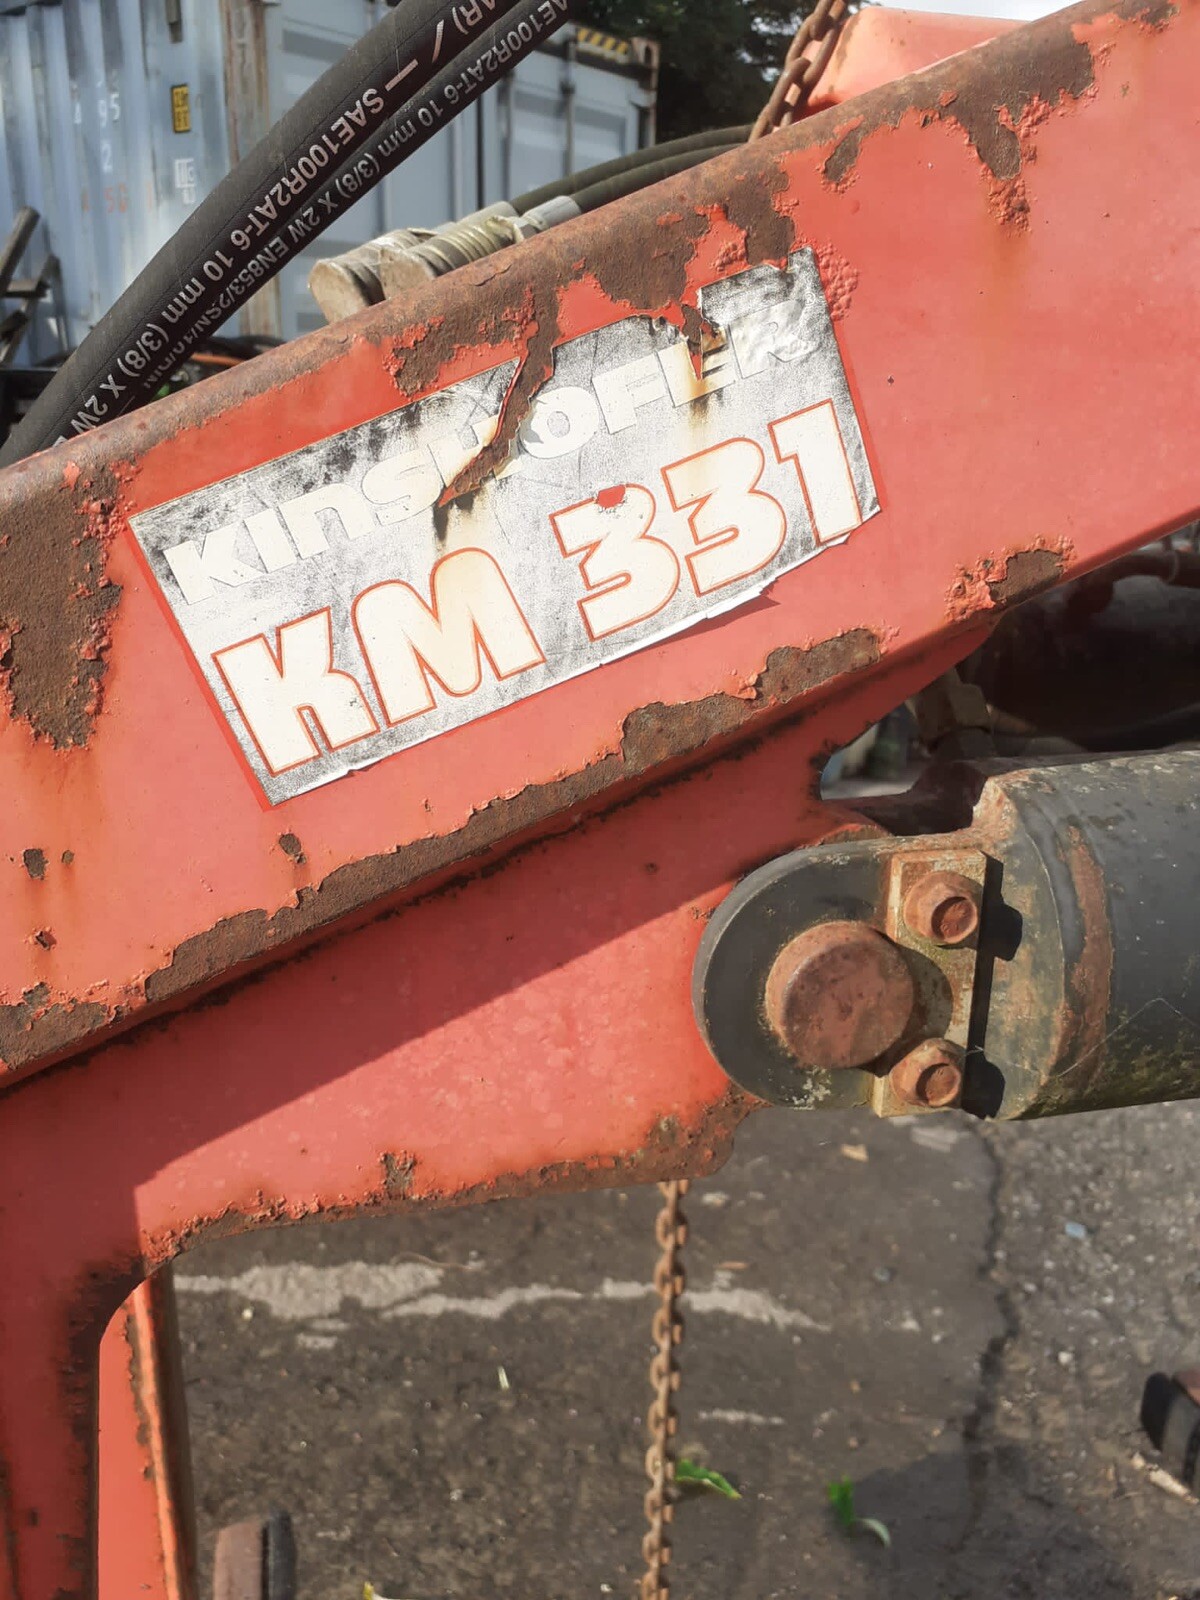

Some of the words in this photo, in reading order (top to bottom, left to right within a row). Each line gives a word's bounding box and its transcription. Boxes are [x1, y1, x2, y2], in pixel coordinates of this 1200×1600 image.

[417, 100, 444, 127] 10
[378, 119, 417, 157] mm
[230, 88, 385, 251] SAE100R2AT-6
[335, 152, 381, 198] (3/8)
[318, 191, 339, 214] X
[287, 206, 321, 243] 2W
[202, 250, 235, 282] 10
[161, 277, 207, 324] mm
[117, 323, 170, 378] (3/8)
[99, 373, 127, 399] X
[70, 394, 109, 434] 2W
[211, 547, 546, 777] KM
[550, 398, 864, 643] 331
